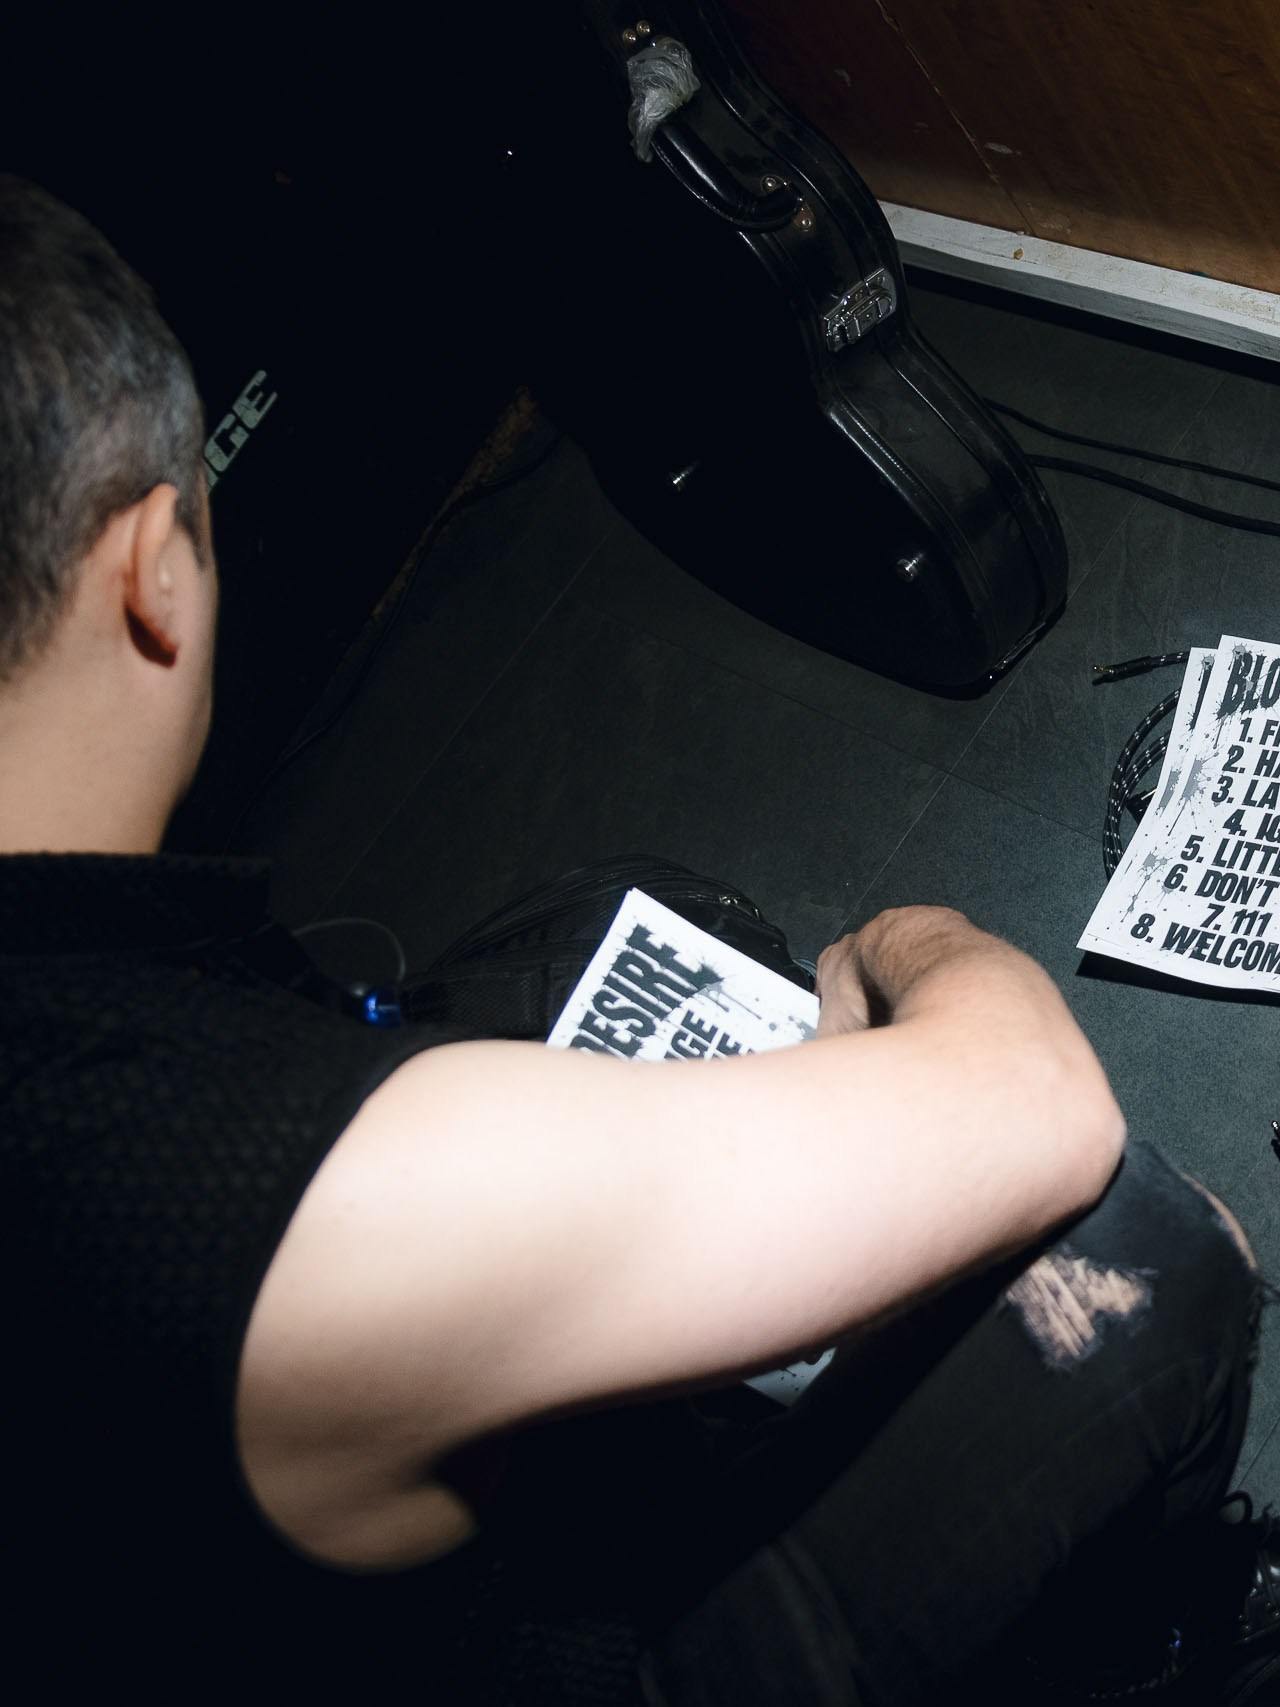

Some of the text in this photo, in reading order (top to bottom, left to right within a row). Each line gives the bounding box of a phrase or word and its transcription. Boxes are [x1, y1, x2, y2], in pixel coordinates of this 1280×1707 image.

[1239, 718, 1253, 743] 1.
[1222, 745, 1245, 773] 2.
[1212, 775, 1234, 803] 3.
[1245, 780, 1280, 810] LA
[1223, 809, 1247, 836] 4.
[1181, 836, 1204, 863] 5.
[1164, 864, 1188, 892] 6.
[1195, 870, 1278, 907] DON'T
[1131, 914, 1155, 943] 8.
[1200, 904, 1272, 937] 7. 111
